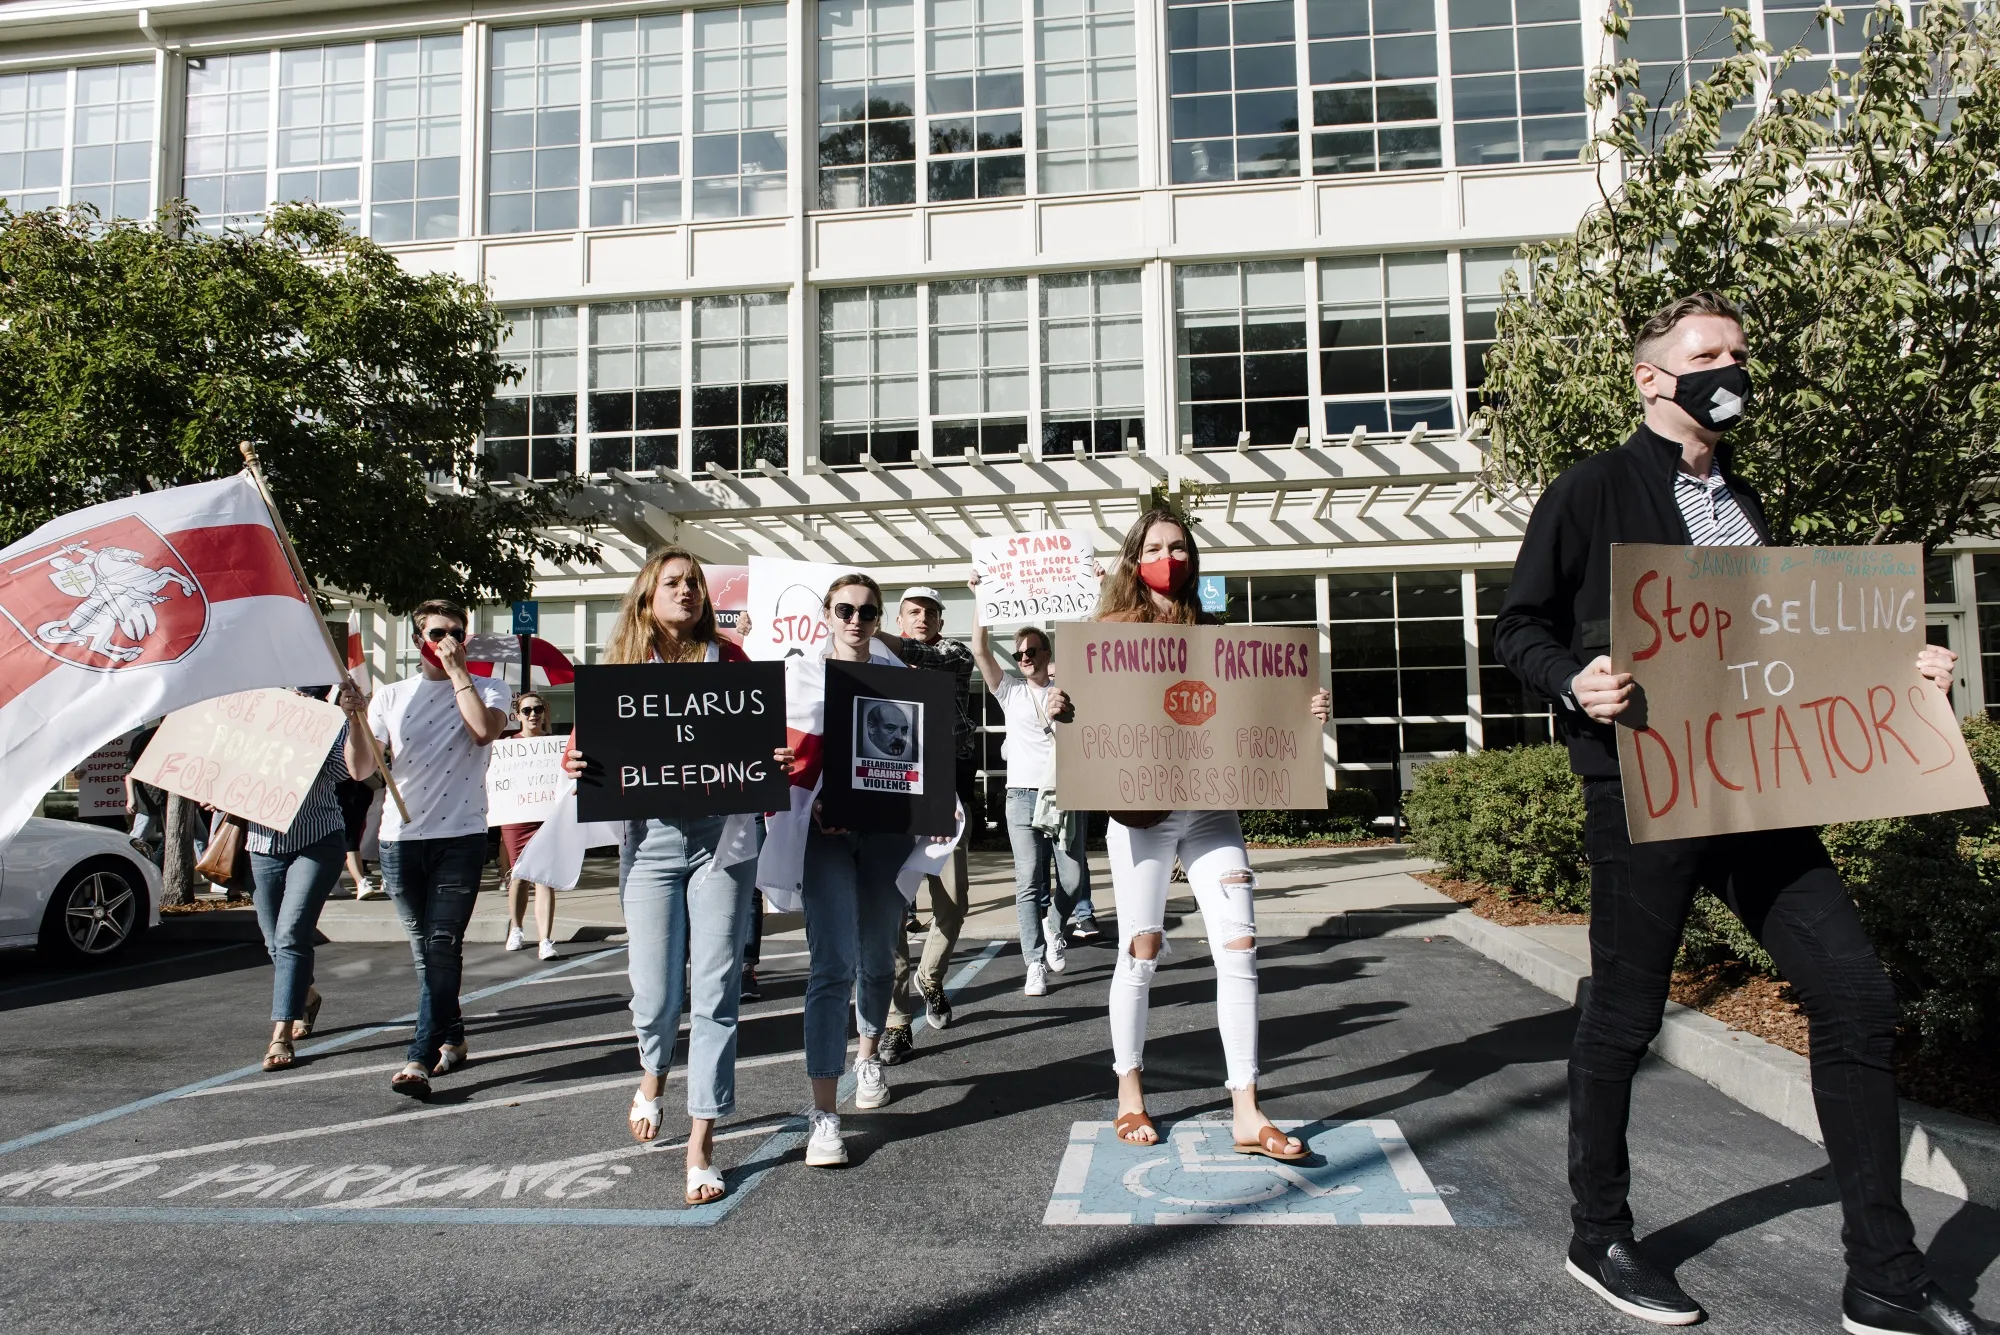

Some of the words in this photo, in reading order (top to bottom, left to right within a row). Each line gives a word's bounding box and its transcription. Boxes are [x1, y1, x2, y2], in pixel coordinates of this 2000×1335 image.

[1007, 535, 1072, 556] STAND
[987, 562, 1013, 574] WITH
[1020, 559, 1037, 567] THE
[1043, 556, 1080, 565] PEOPLE
[1000, 570, 1012, 580] OF
[1020, 567, 1071, 577] BELARUS
[1684, 549, 1770, 580] SANDVINE
[1780, 556, 1806, 573] &
[1812, 549, 1893, 567] FRANCISCO
[1844, 562, 1916, 577] PARTNERS
[1021, 576, 1044, 585] THEIR
[1028, 584, 1050, 597] for
[986, 593, 1100, 619] DEMOCRACY
[1751, 580, 1918, 635] SELLING
[772, 615, 829, 645] STOP
[1086, 637, 1188, 674] FRANCISCO
[1214, 638, 1308, 681] PARTNERS
[1727, 660, 1795, 700] TO
[617, 689, 765, 719] BELARUS
[1168, 690, 1213, 714] STOP
[266, 701, 333, 747] YOUR
[677, 724, 695, 743] IS
[207, 724, 295, 780] POWER
[1081, 724, 1213, 760] PROFITING
[1236, 726, 1297, 761] FROM
[1632, 685, 1955, 819] DICTATORS
[621, 760, 767, 791] BLEEDING
[861, 760, 913, 770] BELARUSIANS
[868, 769, 907, 779] AGAINST
[154, 752, 221, 800] FOR
[224, 774, 298, 823] GOOD
[863, 778, 911, 790] VIOLENCE
[1118, 765, 1291, 806] OPPRESSION
[158, 1163, 632, 1200] PARKING
